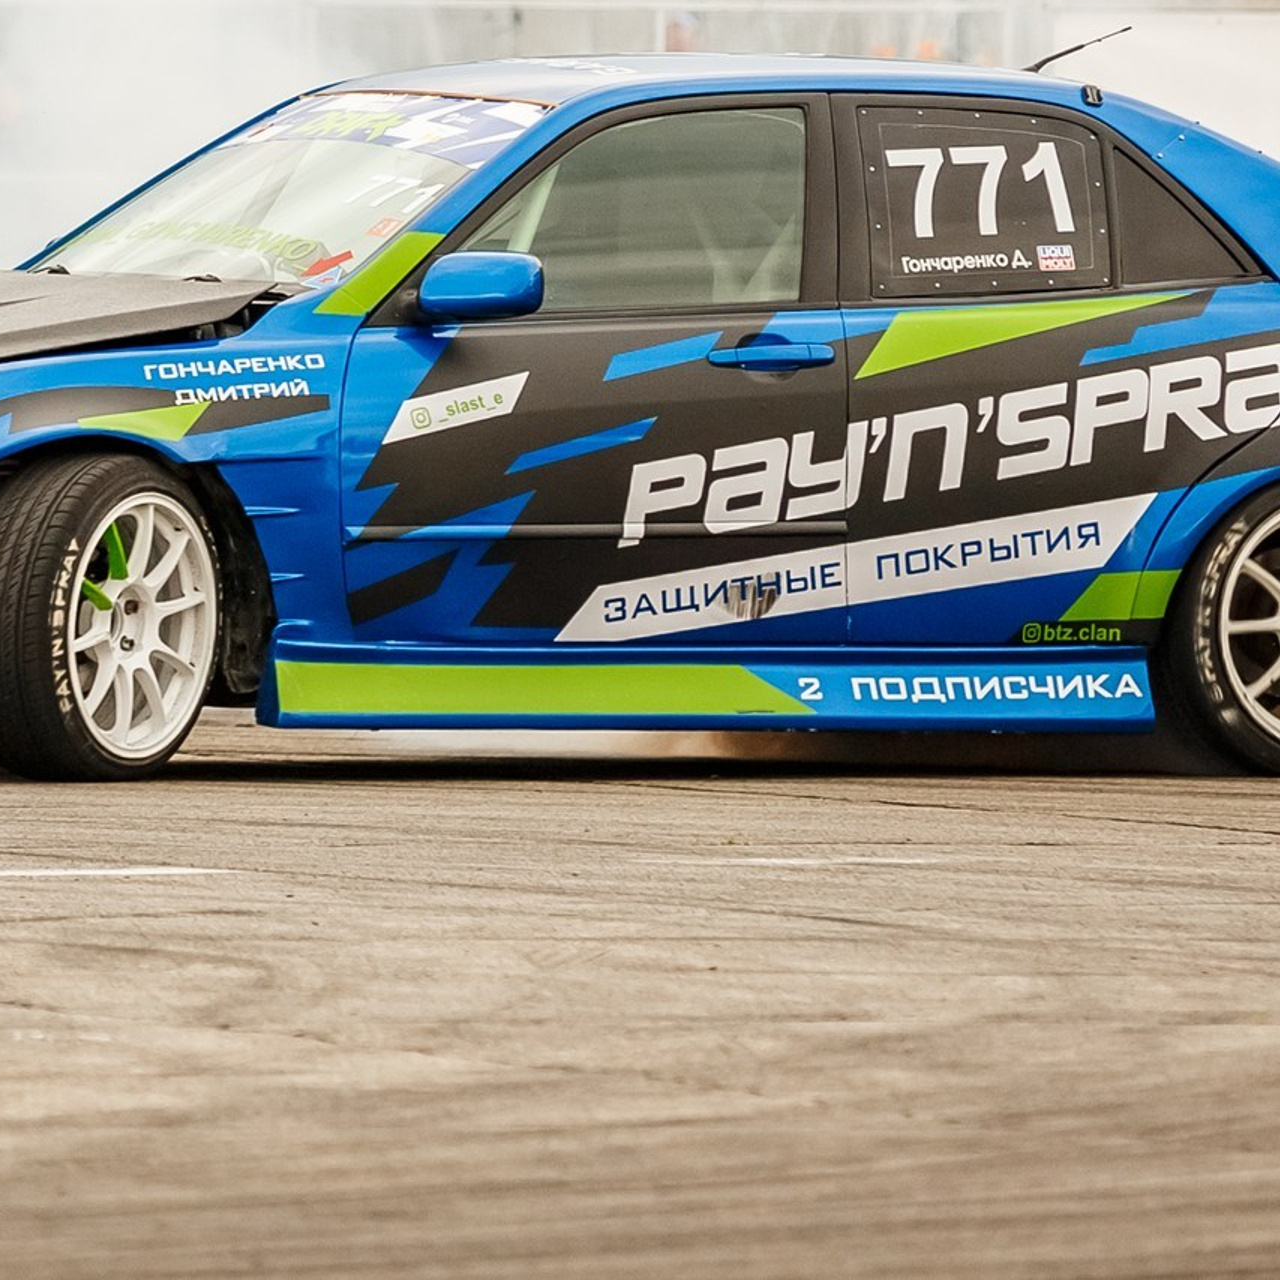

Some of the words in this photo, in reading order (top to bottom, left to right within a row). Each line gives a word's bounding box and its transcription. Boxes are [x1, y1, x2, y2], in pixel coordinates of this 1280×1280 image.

[885, 142, 1075, 238] 771
[901, 252, 1009, 274] Гончаренко
[1011, 249, 1033, 269] Д.
[143, 353, 326, 381] ГОНЧАРЕНКО
[174, 378, 310, 406] ДМИТРИЙ
[603, 562, 843, 623] ЗАЩИТНЫЕ
[875, 521, 1102, 580] ПОКРЫТИЯ
[1043, 623, 1122, 641] btz.clan
[797, 677, 824, 702] 2
[851, 673, 1144, 704] ПОДПИСЧИКА
